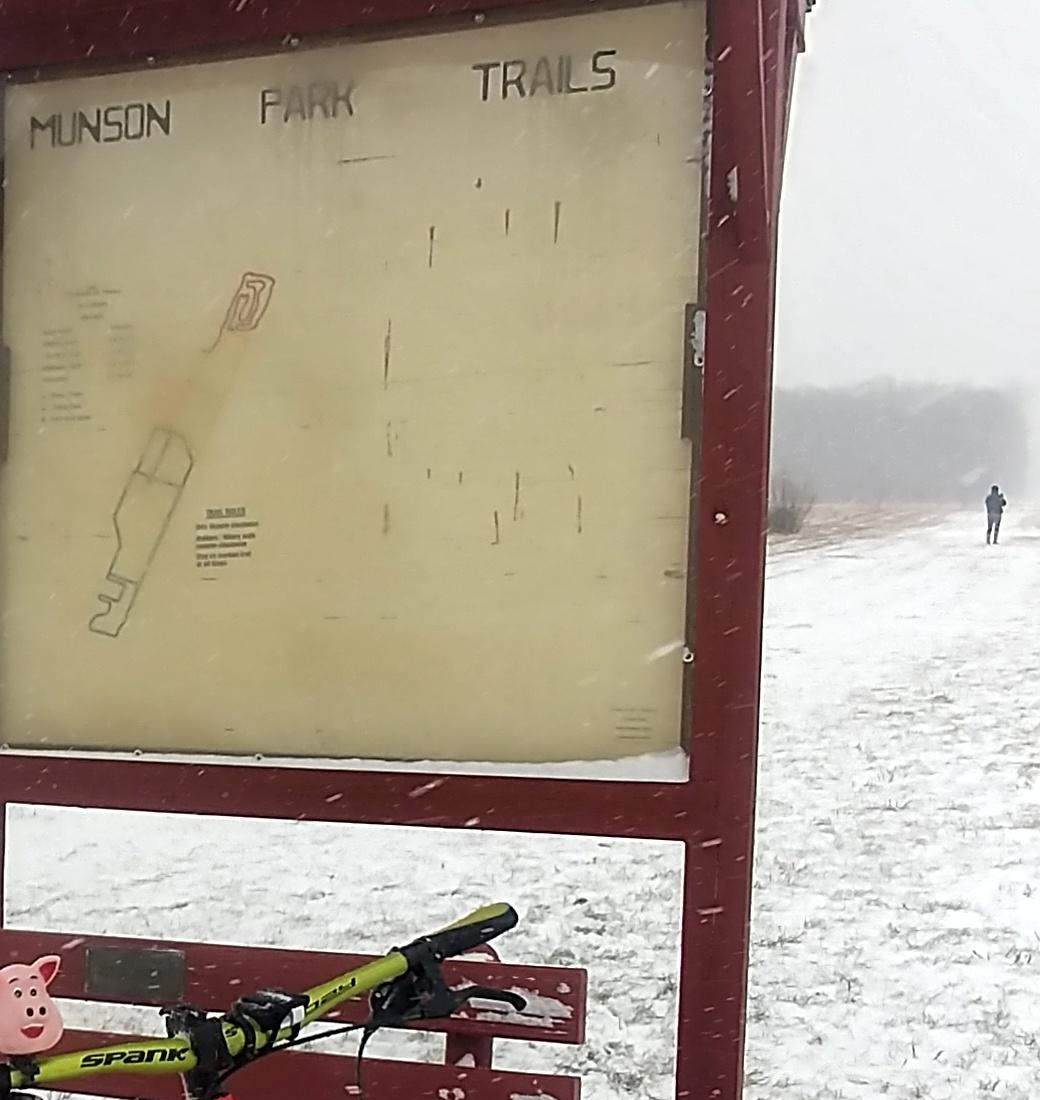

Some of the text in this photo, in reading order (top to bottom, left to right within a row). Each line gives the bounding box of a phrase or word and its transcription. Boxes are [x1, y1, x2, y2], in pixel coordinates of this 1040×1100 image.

[30, 49, 617, 150] MUNSON PARK TRAILS
